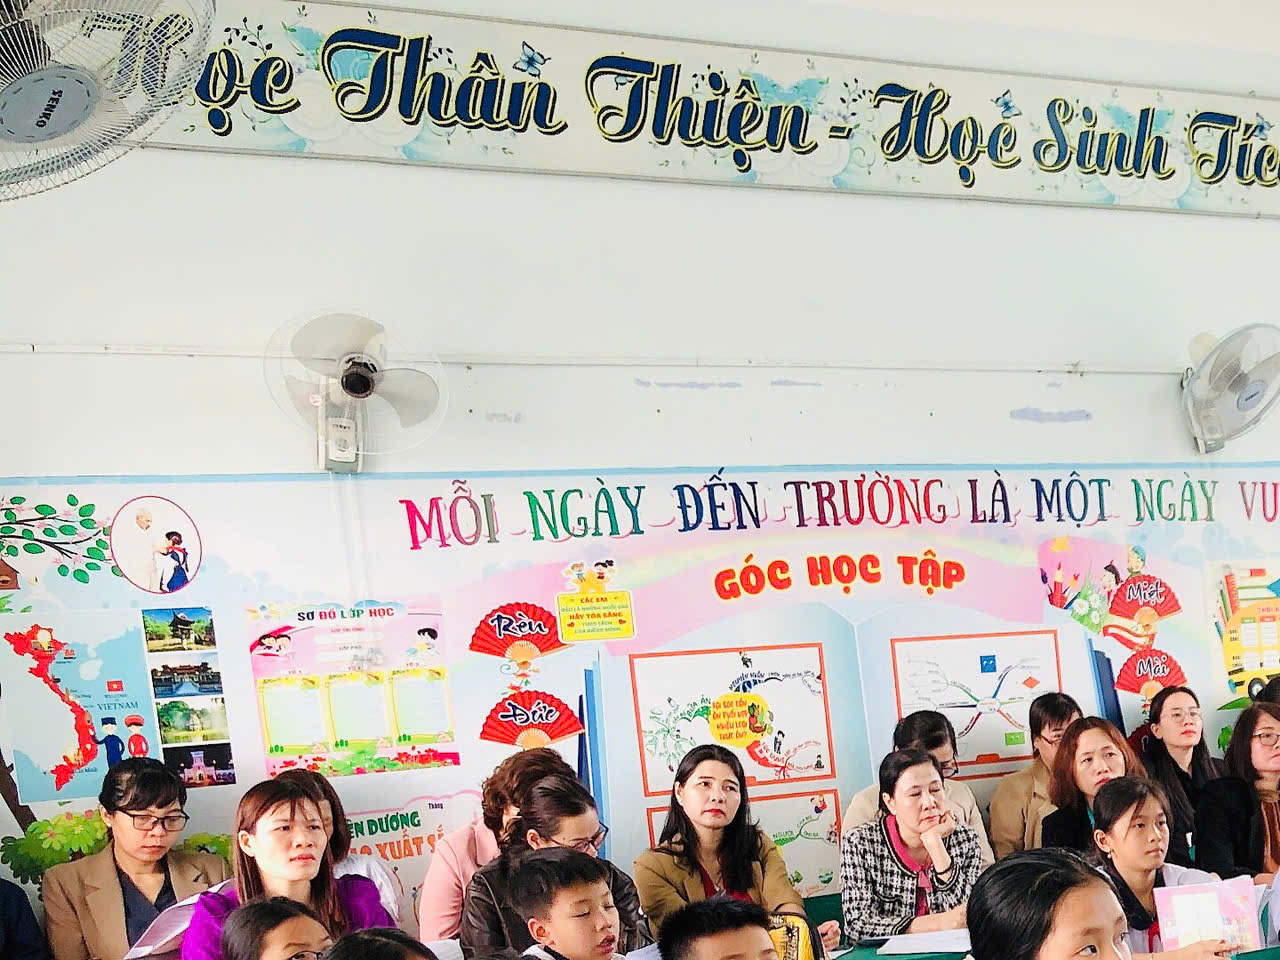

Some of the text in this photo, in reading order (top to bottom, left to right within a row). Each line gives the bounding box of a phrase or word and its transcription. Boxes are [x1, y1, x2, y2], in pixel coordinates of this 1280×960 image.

[35, 89, 63, 128] SENKO
[320, 27, 569, 136] Thân
[584, 54, 817, 174] Thiện
[874, 82, 1022, 189] Học
[1032, 96, 1176, 179] Sinh
[399, 479, 499, 551] MỖI
[523, 478, 646, 541] NGÀY
[673, 468, 762, 531] ĐẾN
[784, 471, 951, 528] TRƯỜNG
[968, 470, 1013, 524] LÀ
[1031, 471, 1112, 529] MỘT
[1131, 471, 1219, 524] NGÀY
[714, 549, 966, 601] GÓC HỌC TẬP
[1128, 581, 1164, 605] Miệt
[297, 607, 394, 621] SƠ ĐỒ LỚP HỌC
[489, 611, 549, 639] Rèn
[1138, 656, 1168, 679] Mài
[97, 701, 139, 711] VIETNAM
[500, 697, 560, 725] Đức
[367, 811, 421, 836] DƯƠNG
[375, 828, 424, 861] XUẤT
